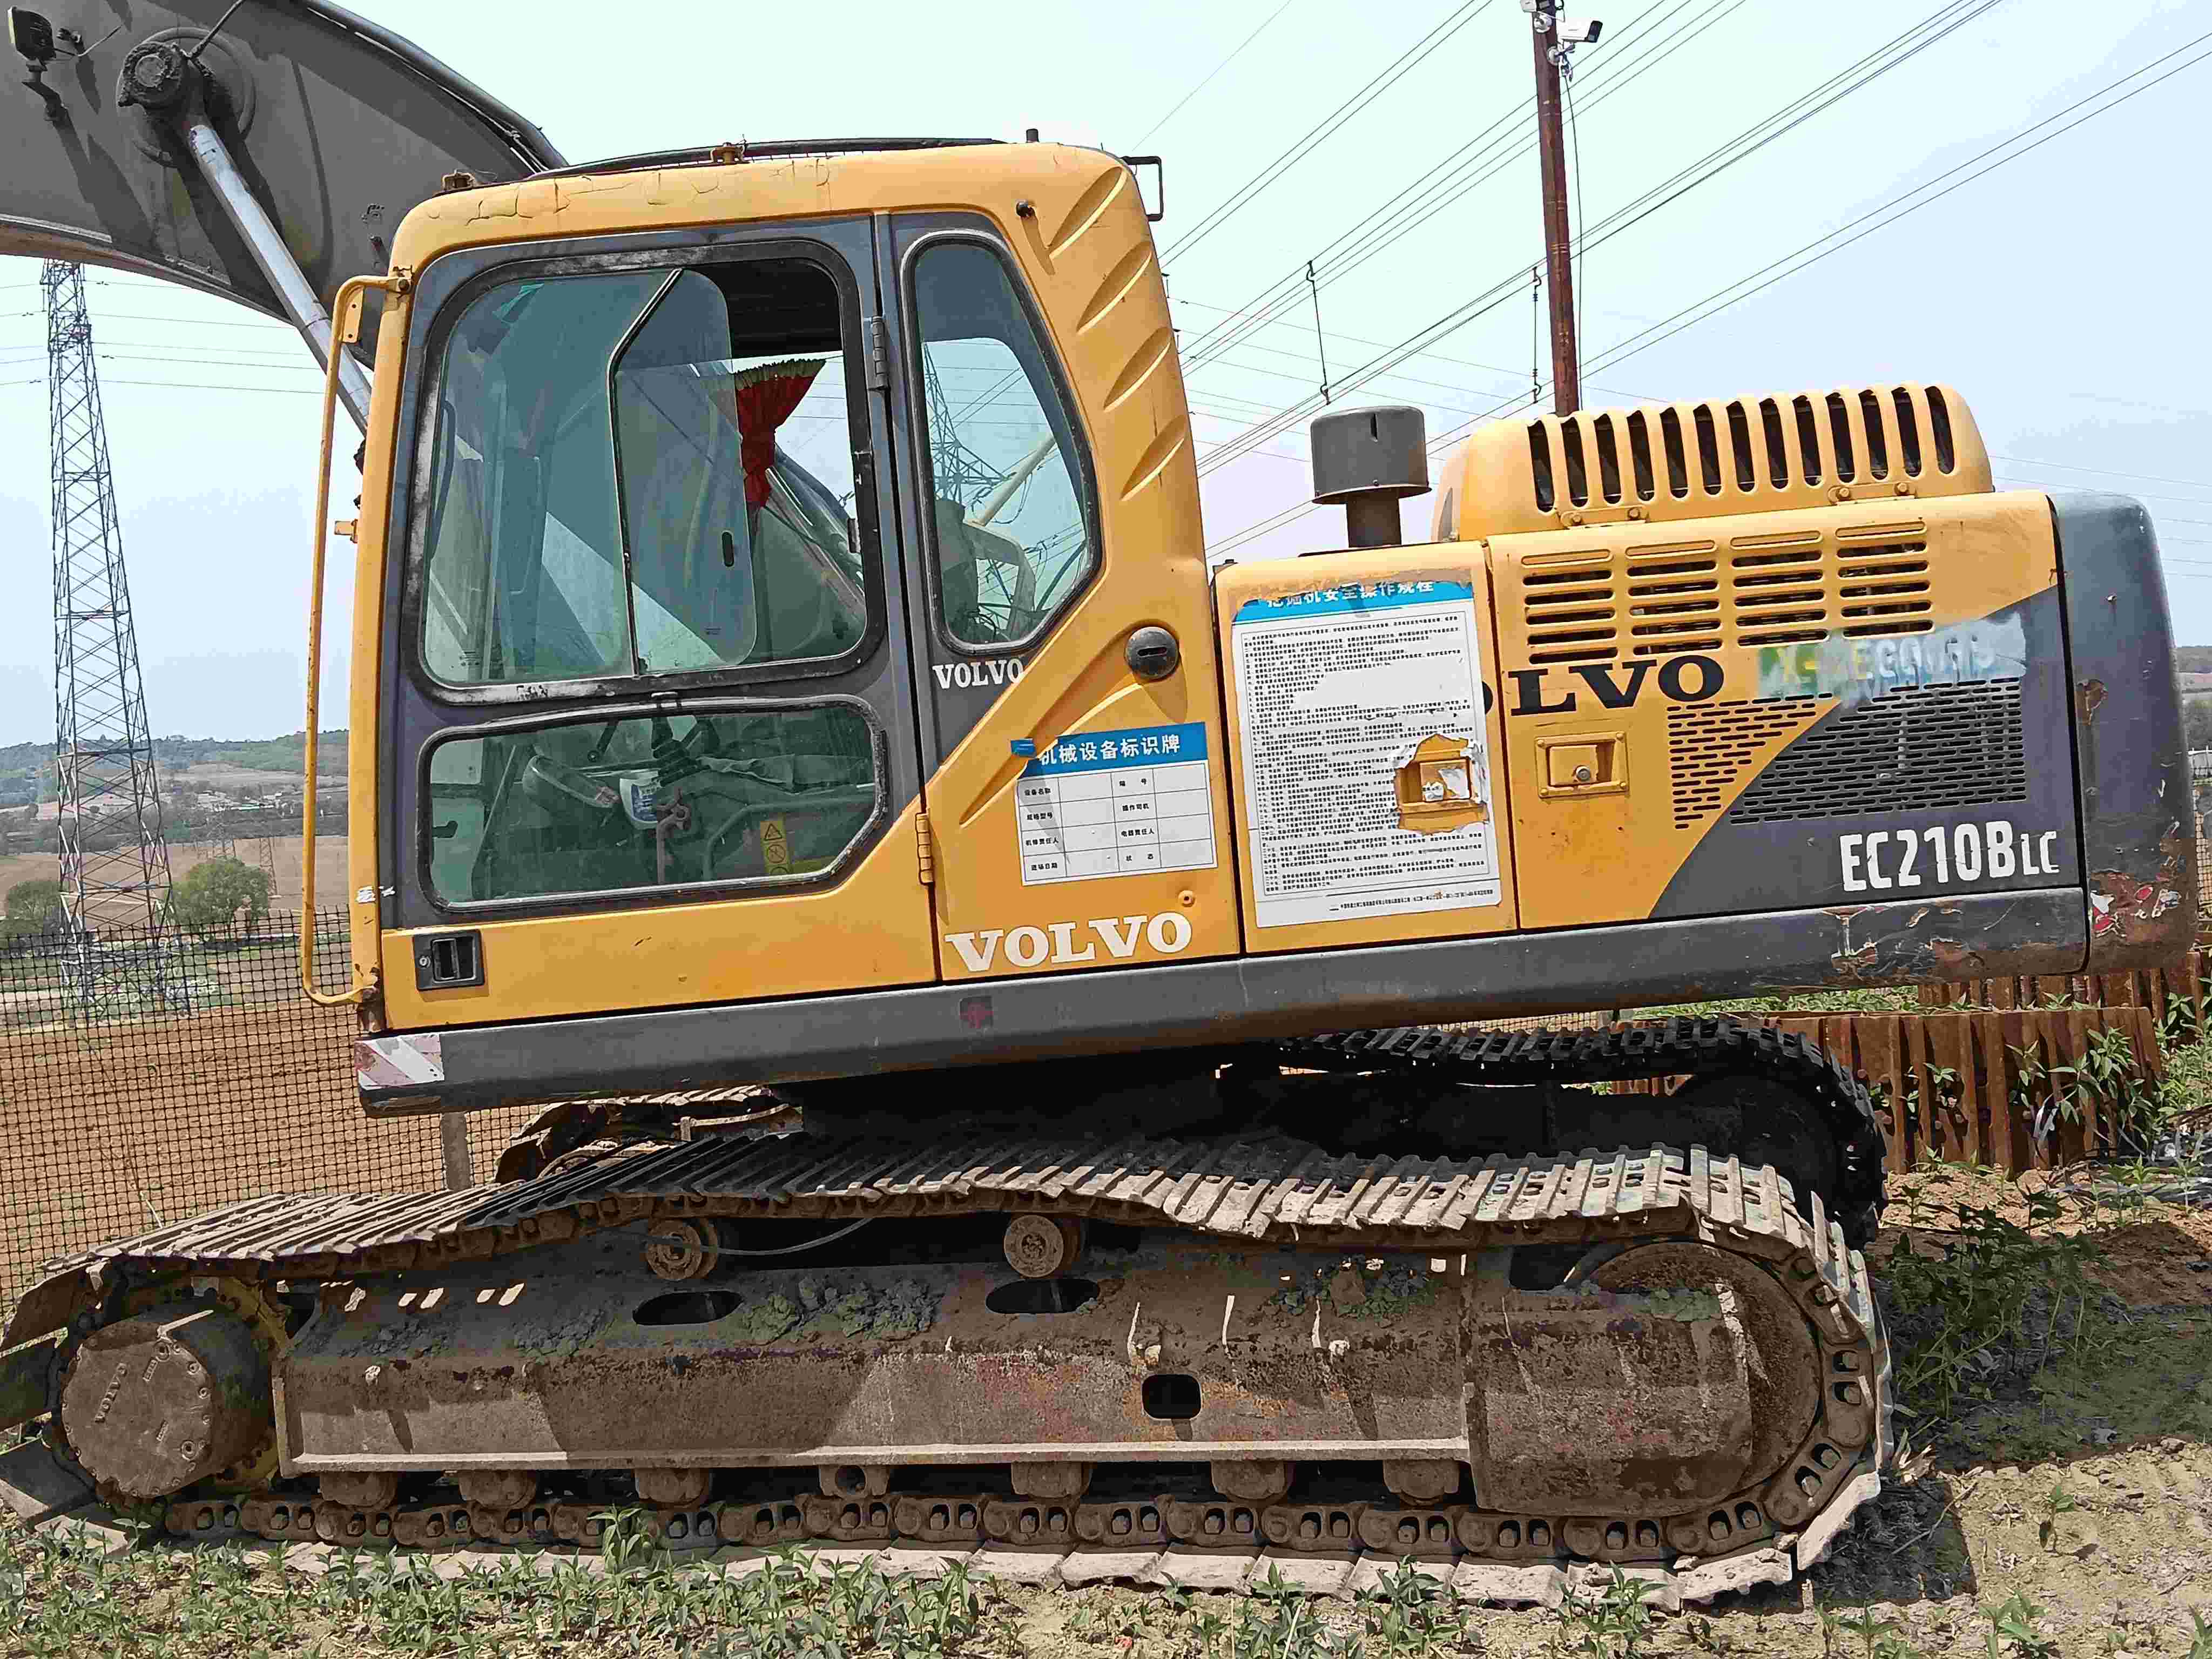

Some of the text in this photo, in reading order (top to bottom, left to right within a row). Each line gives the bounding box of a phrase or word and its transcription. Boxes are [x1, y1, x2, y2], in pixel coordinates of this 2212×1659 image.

[932, 658, 1025, 689] VOLVO
[1482, 655, 1724, 716] LVO
[1040, 734, 1180, 765] 机械设备标识牌
[946, 911, 1192, 973] VOLVO
